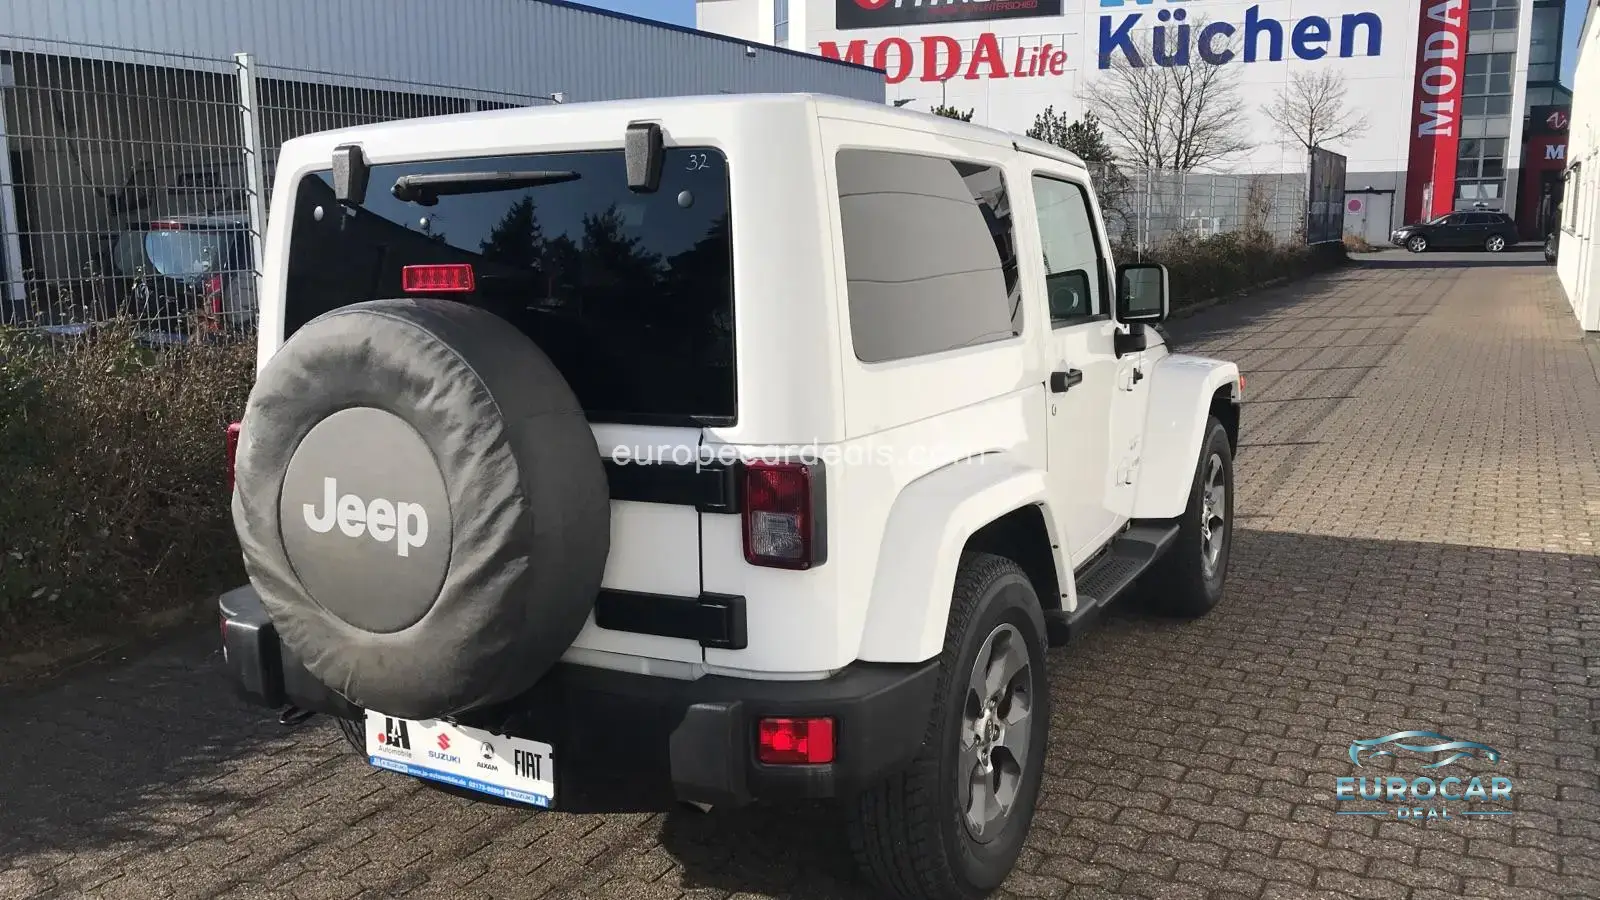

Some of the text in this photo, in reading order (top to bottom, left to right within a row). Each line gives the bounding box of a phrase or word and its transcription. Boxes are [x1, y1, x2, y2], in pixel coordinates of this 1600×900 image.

[1098, 4, 1383, 69] Küchen
[818, 33, 1068, 84] MODA Life
[1418, 0, 1463, 138] MODA
[686, 153, 710, 171] 32
[302, 476, 429, 557] Jeep
[378, 745, 412, 759] Automobile
[428, 750, 461, 765] SUZUKI
[476, 761, 499, 773] AIXAM
[514, 749, 542, 780] FIAT
